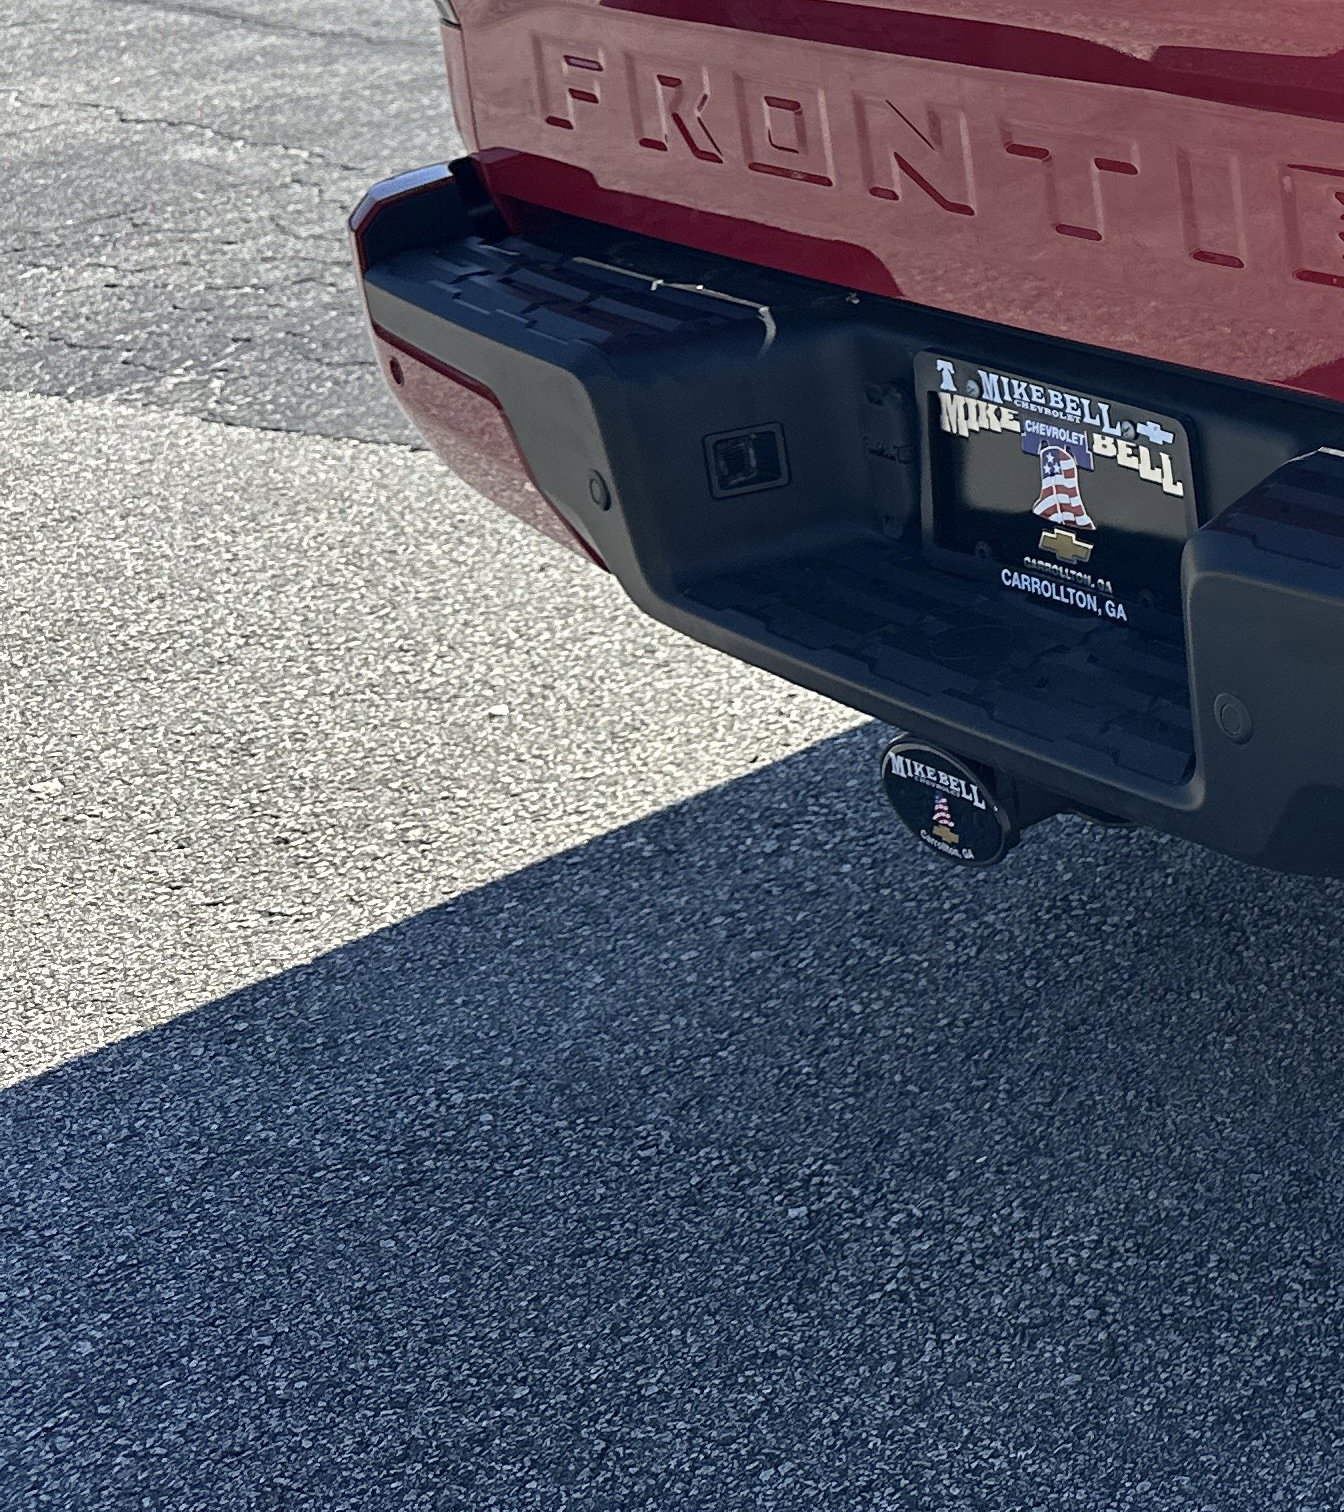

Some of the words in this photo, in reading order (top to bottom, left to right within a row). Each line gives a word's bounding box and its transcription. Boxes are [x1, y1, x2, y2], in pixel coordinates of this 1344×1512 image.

[977, 369, 1046, 405] MIKE
[1048, 389, 1122, 437] BELL
[1013, 398, 1082, 423] CHEVROLET
[937, 391, 1021, 438] MIKE
[1092, 432, 1184, 497] BELL
[1024, 418, 1086, 446] CHEVROLET
[1001, 568, 1102, 616] CARROLLTON,
[1104, 599, 1127, 621] GA
[888, 752, 937, 781] MIKE
[937, 770, 987, 811] BELL
